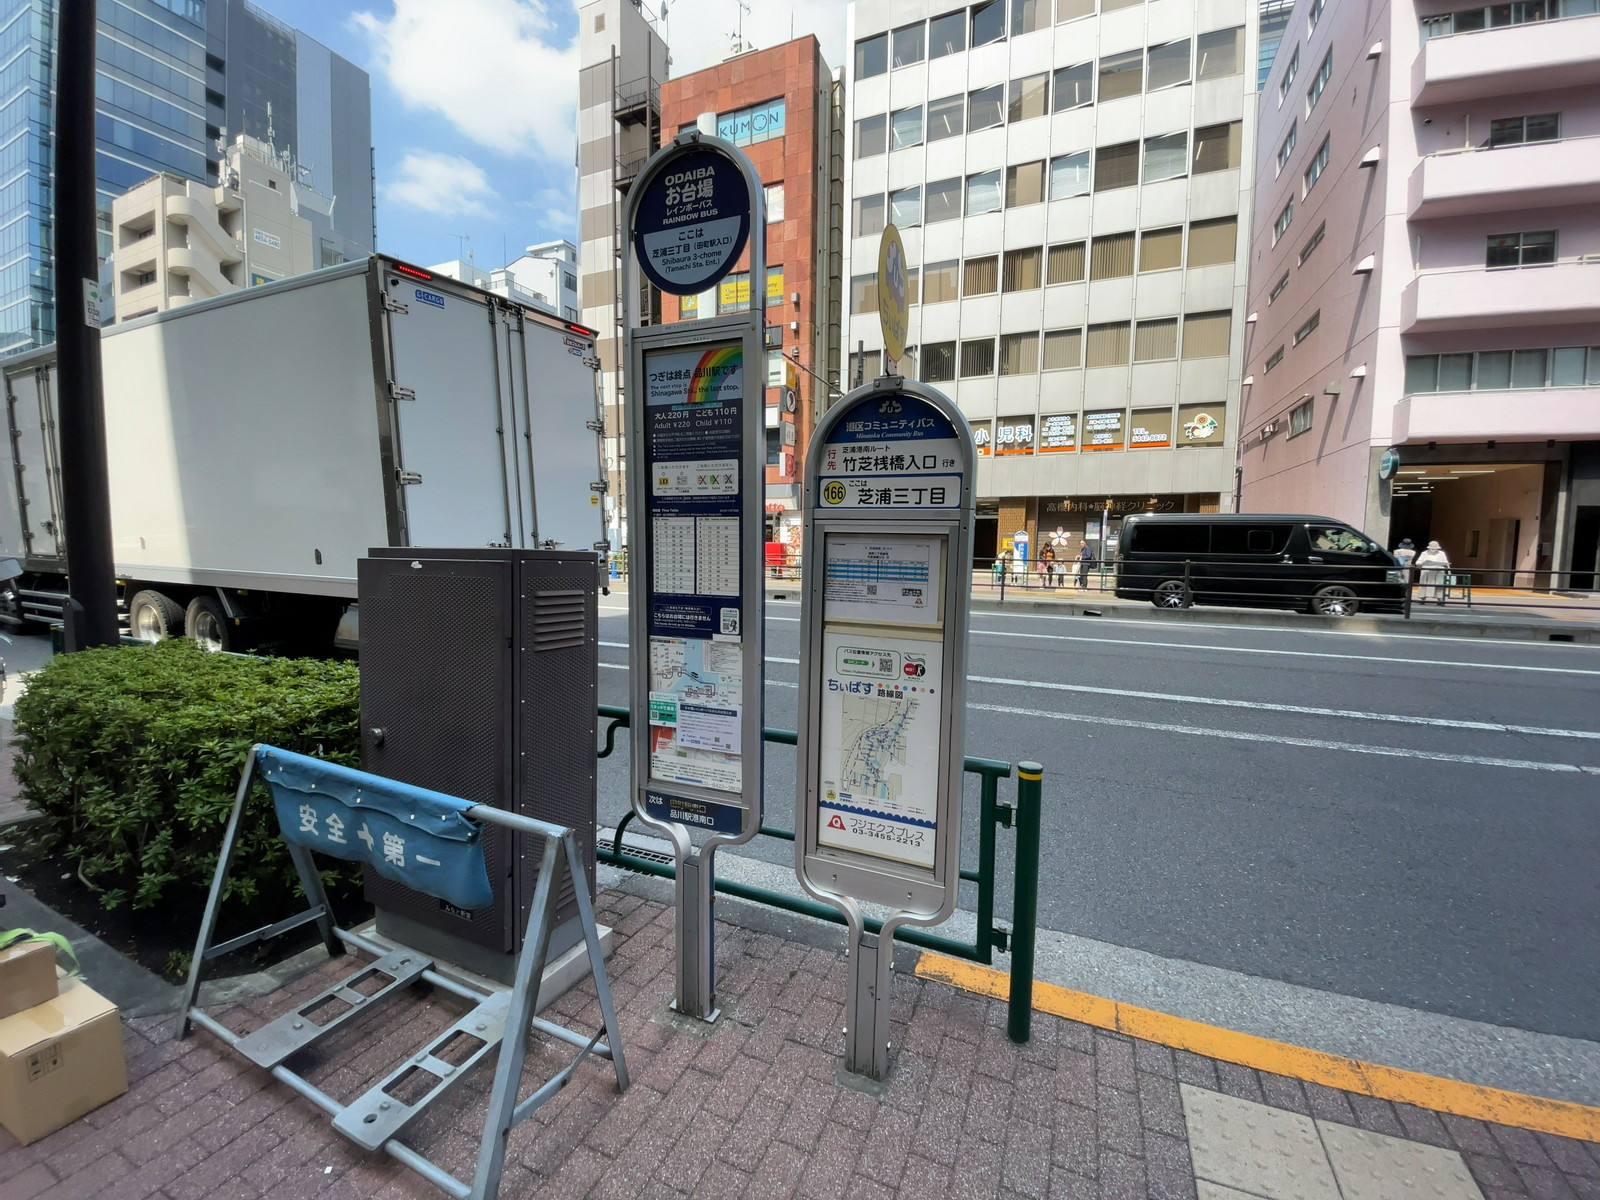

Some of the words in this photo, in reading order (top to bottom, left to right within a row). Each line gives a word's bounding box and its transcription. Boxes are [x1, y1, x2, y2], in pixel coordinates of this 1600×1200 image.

[720, 112, 779, 136] KUMON
[665, 166, 715, 186] ODAIBA
[666, 178, 714, 206] お台場
[666, 200, 713, 216] レインボーバス
[662, 212, 698, 225] RAINBOW
[700, 208, 718, 218] BUS
[678, 228, 704, 241] ここは
[662, 255, 692, 266] Shibaura
[692, 250, 722, 260] 3-chome
[666, 263, 692, 274] (Tamachi
[705, 258, 720, 266] Ent.)
[650, 369, 691, 382] つぎは終点
[694, 364, 738, 378] 品川駅です
[651, 389, 682, 397] Shinagawa
[654, 411, 689, 420] 大人220円
[696, 407, 737, 417] こども110円
[846, 418, 935, 432] 港区コミュニティバス
[976, 426, 1032, 444] 小児科
[842, 445, 890, 453] 芝浦港南ルート
[827, 450, 836, 470] 行先
[843, 455, 936, 472] 竹芝桟橋入口
[942, 459, 955, 467] 行き
[825, 486, 844, 496] 166
[858, 488, 945, 505] 芝浦三丁目
[843, 649, 891, 658] バス位置情報アクセス先
[828, 679, 874, 695] ちぃばす
[877, 689, 903, 699] 路線図
[649, 795, 663, 805] 次は
[670, 810, 714, 826] 品川駅港南口
[299, 804, 347, 845] 安全
[383, 831, 440, 868] 第一
[850, 818, 924, 841] フジエクスプレス
[853, 828, 920, 846] 03-3455-2213
